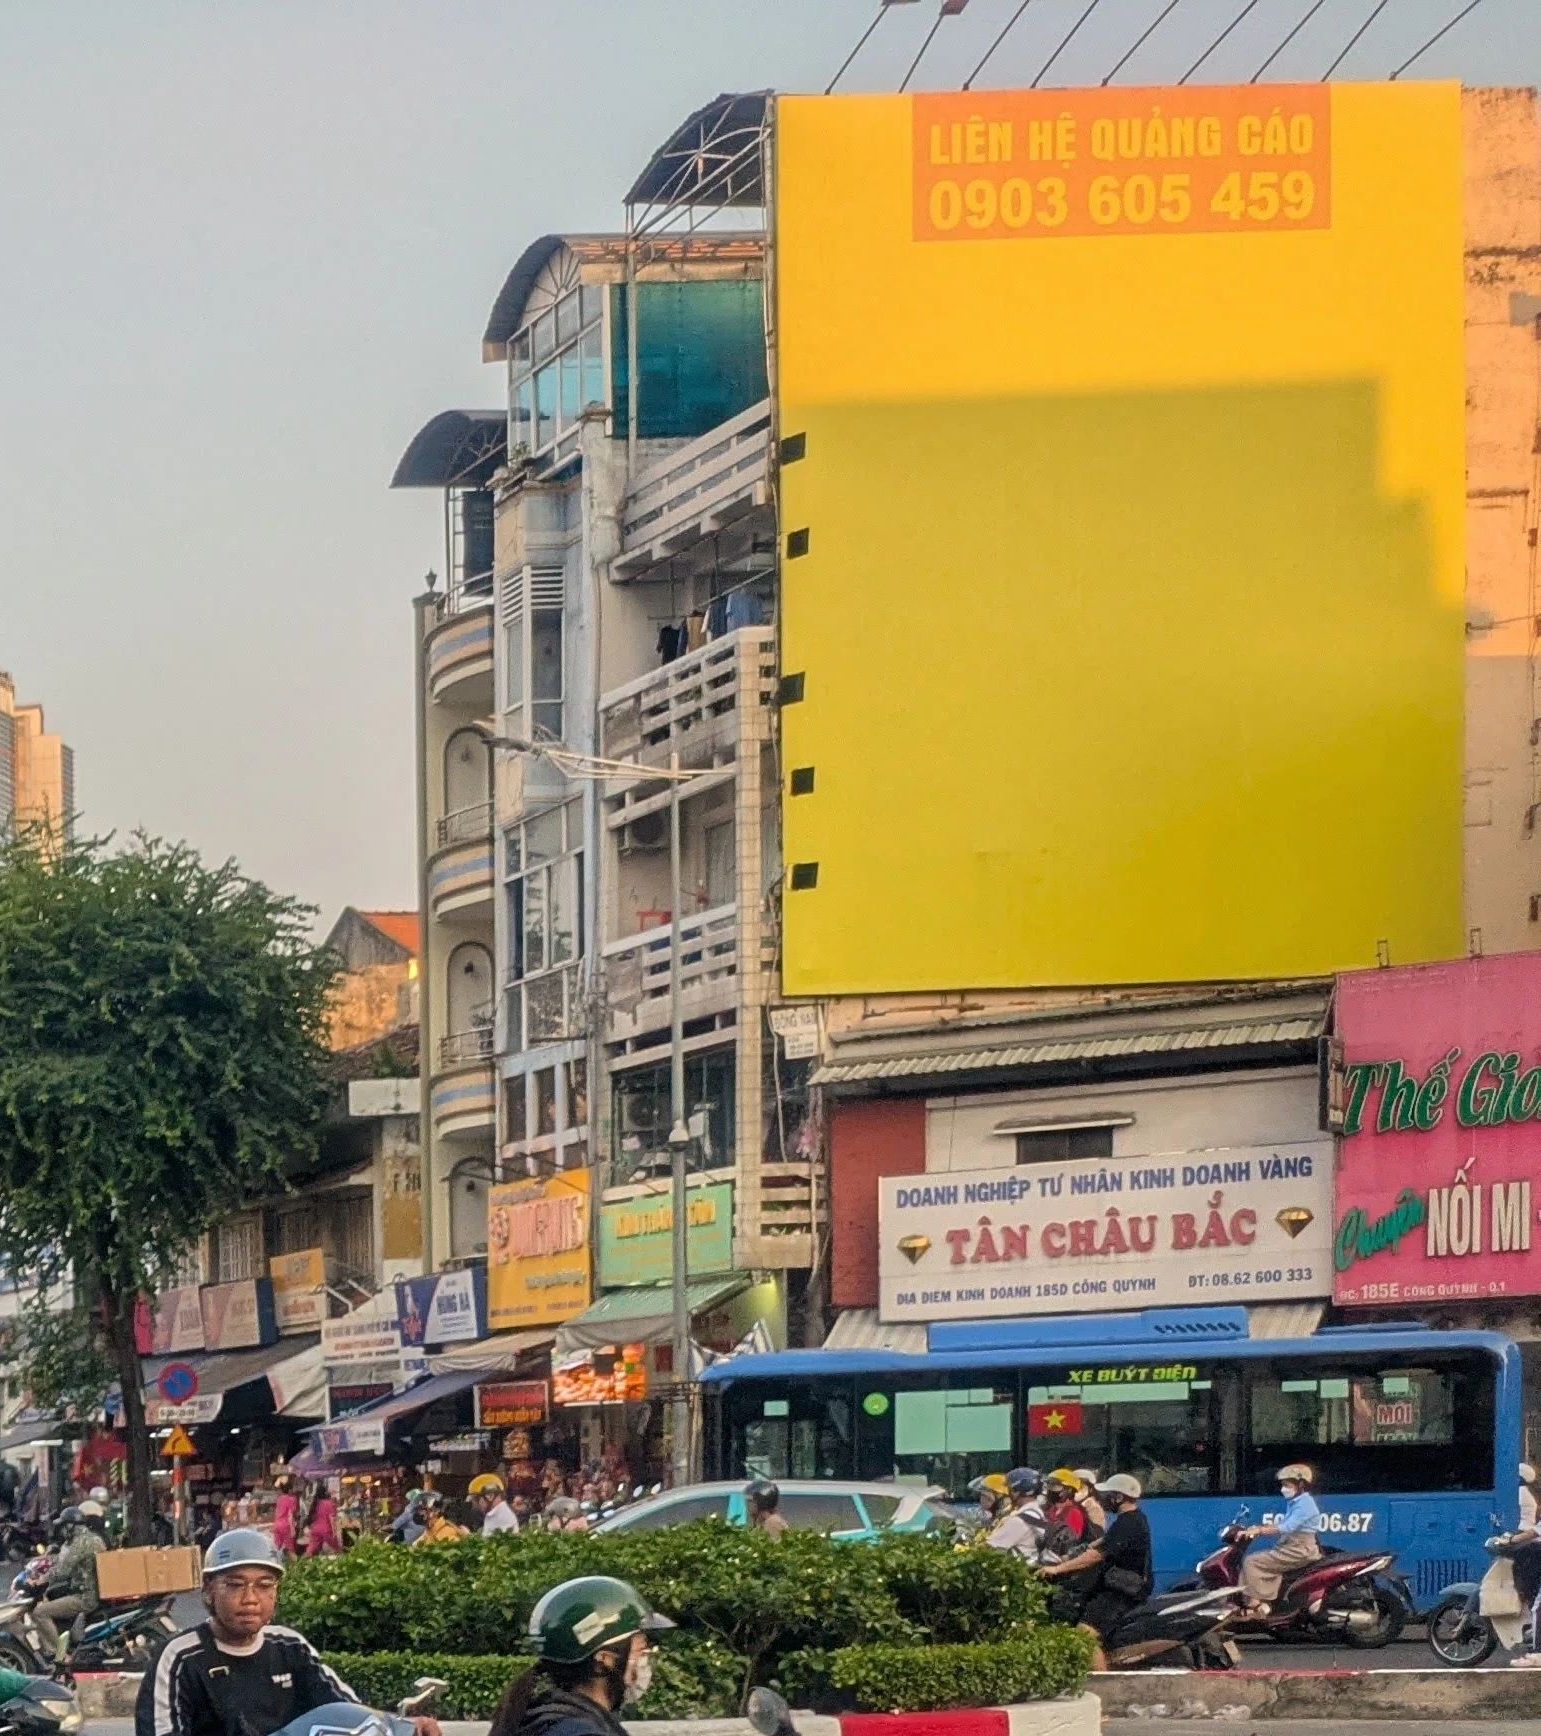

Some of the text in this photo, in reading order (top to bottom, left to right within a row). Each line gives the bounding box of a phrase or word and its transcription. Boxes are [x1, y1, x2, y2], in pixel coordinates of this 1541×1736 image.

[930, 106, 1313, 168] LIÊN HỆ QUẢNG CÁO
[929, 170, 1314, 231] 0903 605 459
[1343, 1047, 1461, 1137] Thế
[896, 1155, 1313, 1209] DOANH NGHIỆP TƯ NHÂN KINH DOANH VÀNG
[1426, 1157, 1530, 1257] NỐI MI
[946, 1190, 1257, 1265] TÂN CHÂU BẮC
[956, 1287, 985, 1302] KINH
[990, 1284, 1032, 1300] DOANH
[1036, 1282, 1068, 1296] 185D
[1255, 1269, 1282, 1284] 600
[1287, 1267, 1313, 1282] 333
[1361, 1283, 1398, 1299] 185E
[1068, 1370, 1094, 1383] XE
[1097, 1365, 1150, 1381] BUÝT
